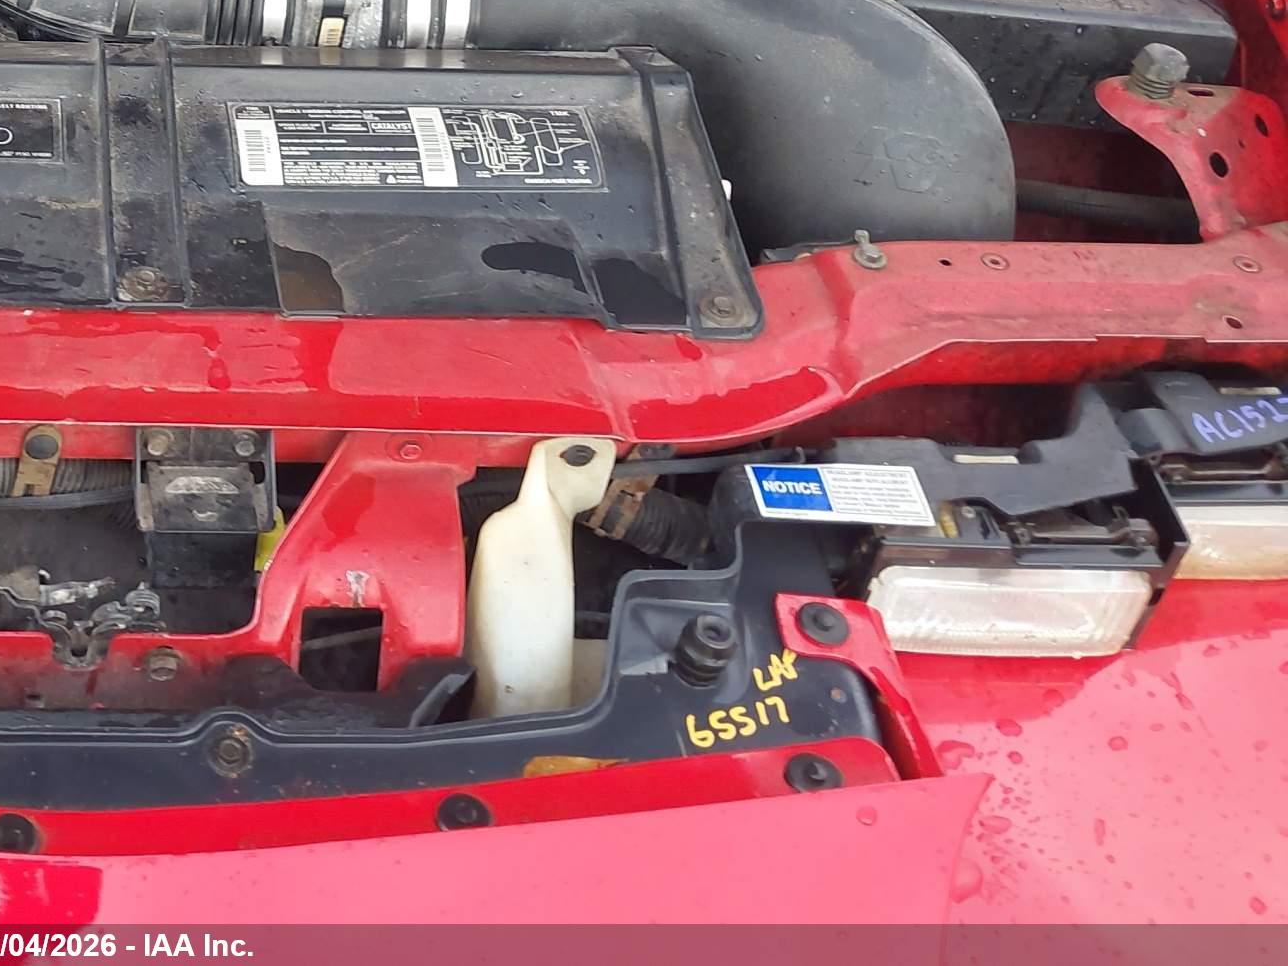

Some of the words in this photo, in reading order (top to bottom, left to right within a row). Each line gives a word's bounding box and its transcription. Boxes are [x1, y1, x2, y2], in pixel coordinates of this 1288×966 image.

[370, 122, 411, 130] CATALYST
[1191, 397, 1288, 443] AC152
[762, 480, 824, 495] NOTICE
